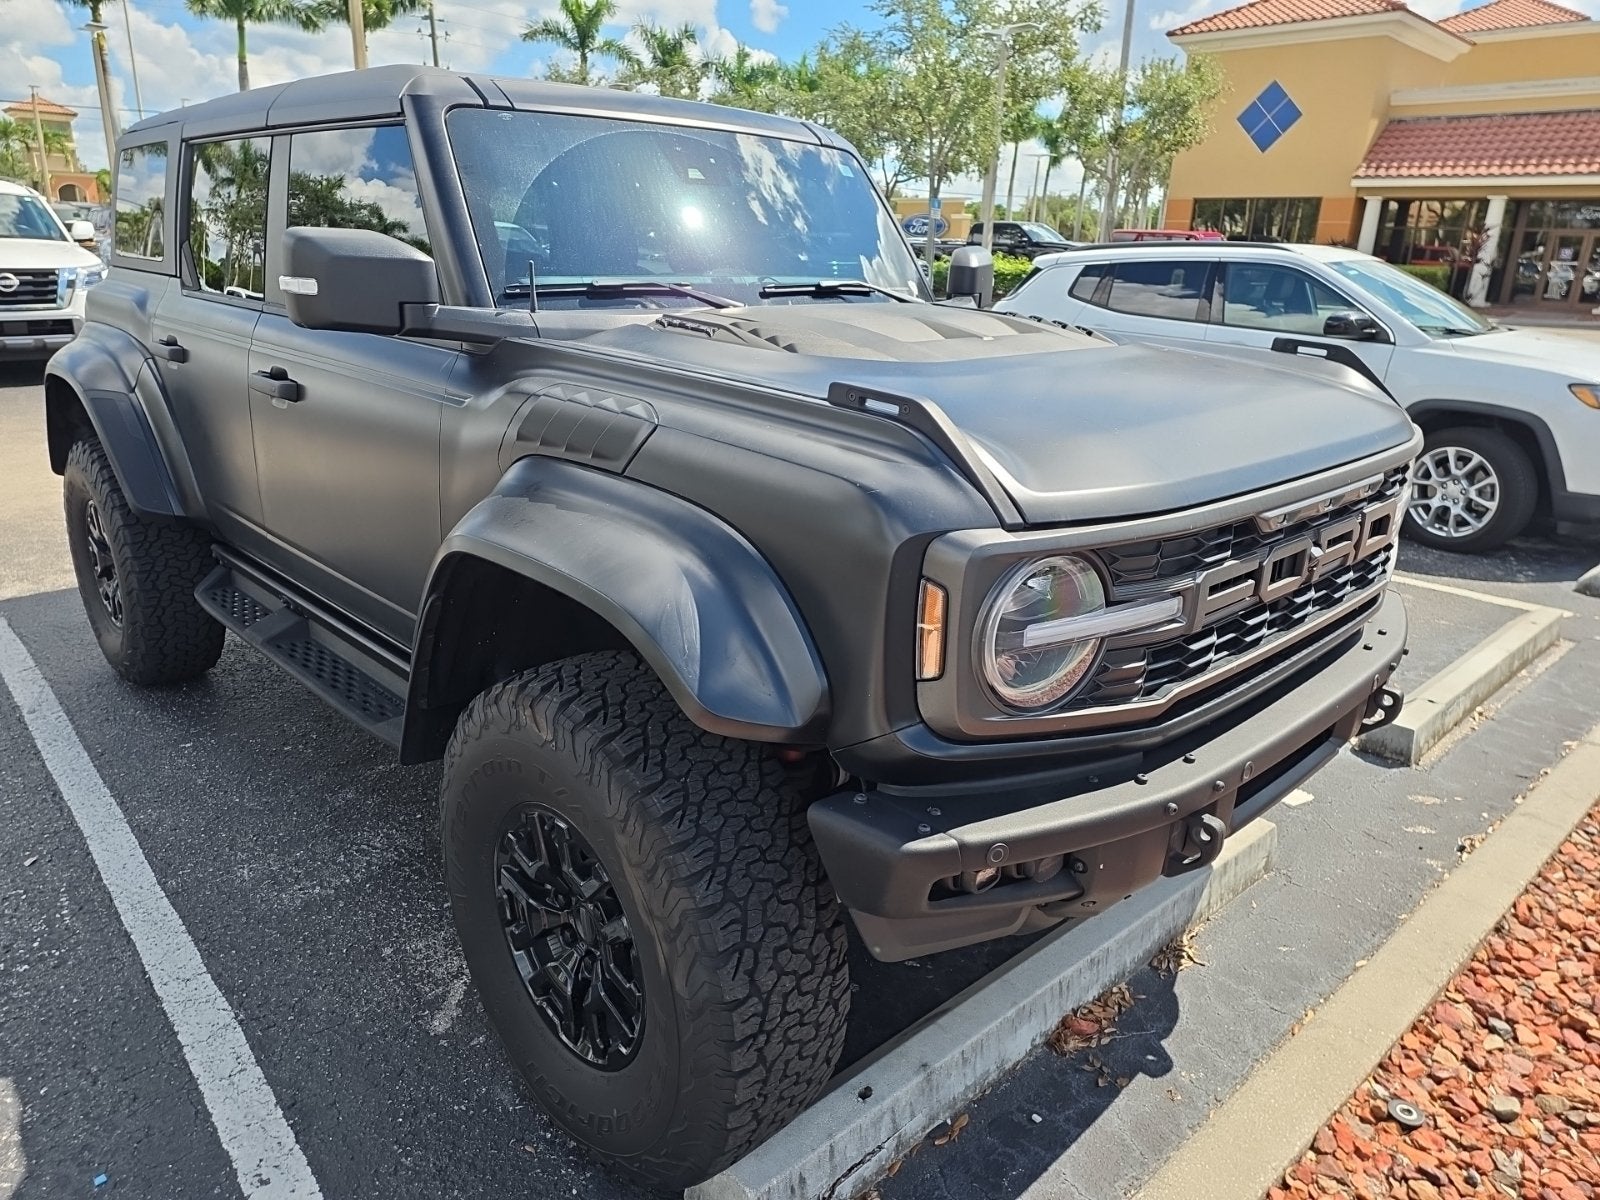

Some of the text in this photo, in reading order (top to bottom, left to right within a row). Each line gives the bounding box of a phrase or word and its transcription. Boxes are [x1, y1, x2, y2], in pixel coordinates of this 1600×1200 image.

[1576, 206, 1600, 220] For
[909, 217, 931, 234] For
[1193, 499, 1398, 633] FORD
